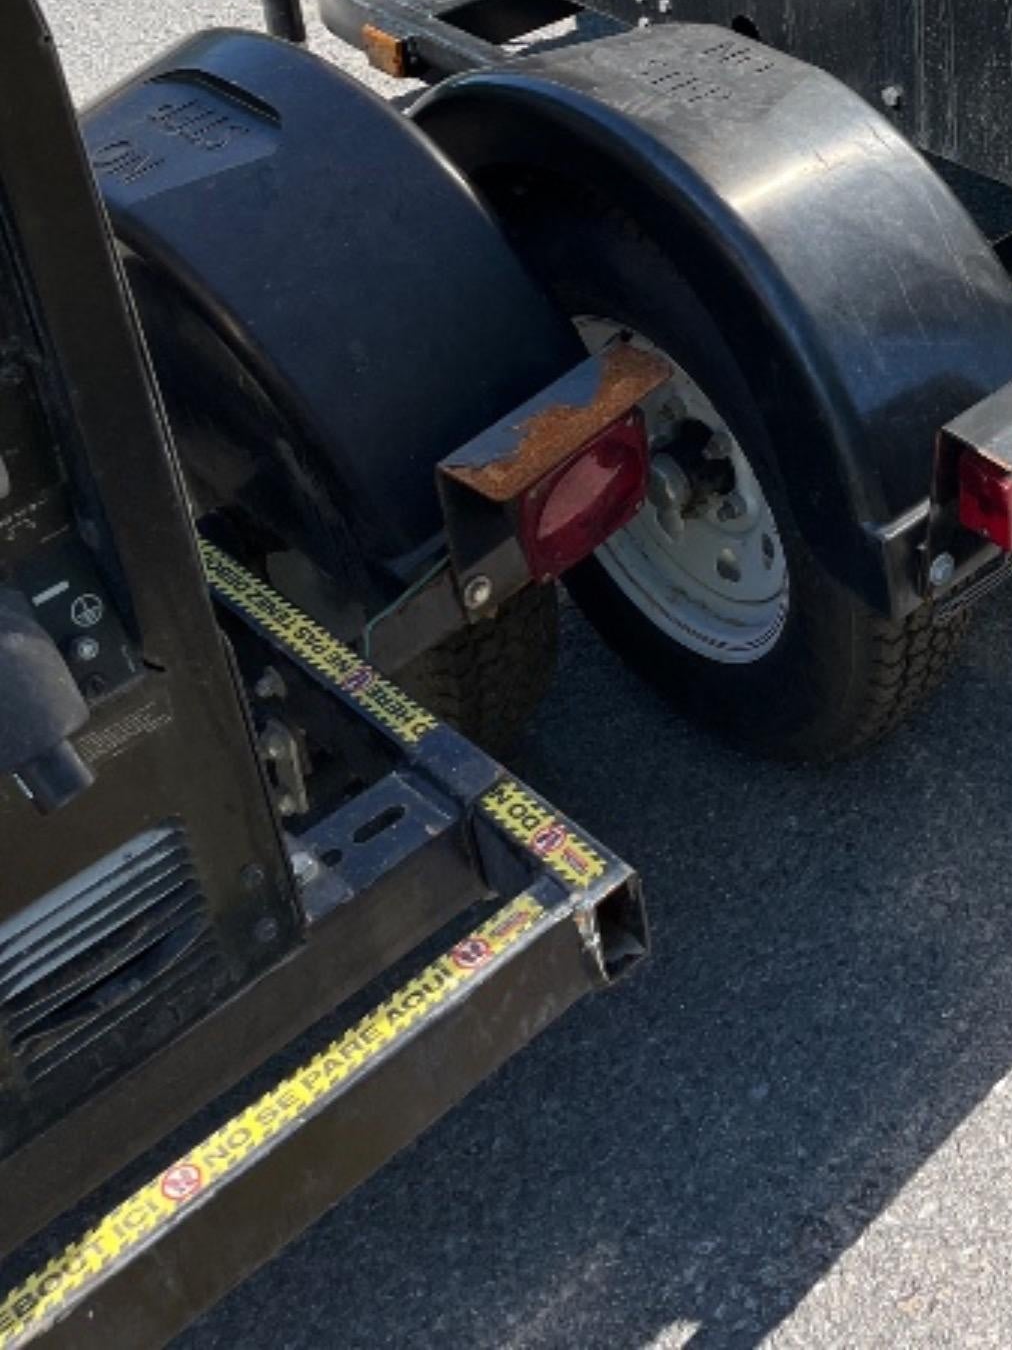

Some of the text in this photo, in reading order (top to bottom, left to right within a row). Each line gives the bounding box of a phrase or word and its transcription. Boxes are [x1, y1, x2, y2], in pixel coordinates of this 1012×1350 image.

[202, 1126, 254, 1169] NO
[254, 1090, 300, 1126] SE
[302, 1024, 386, 1092] PARE
